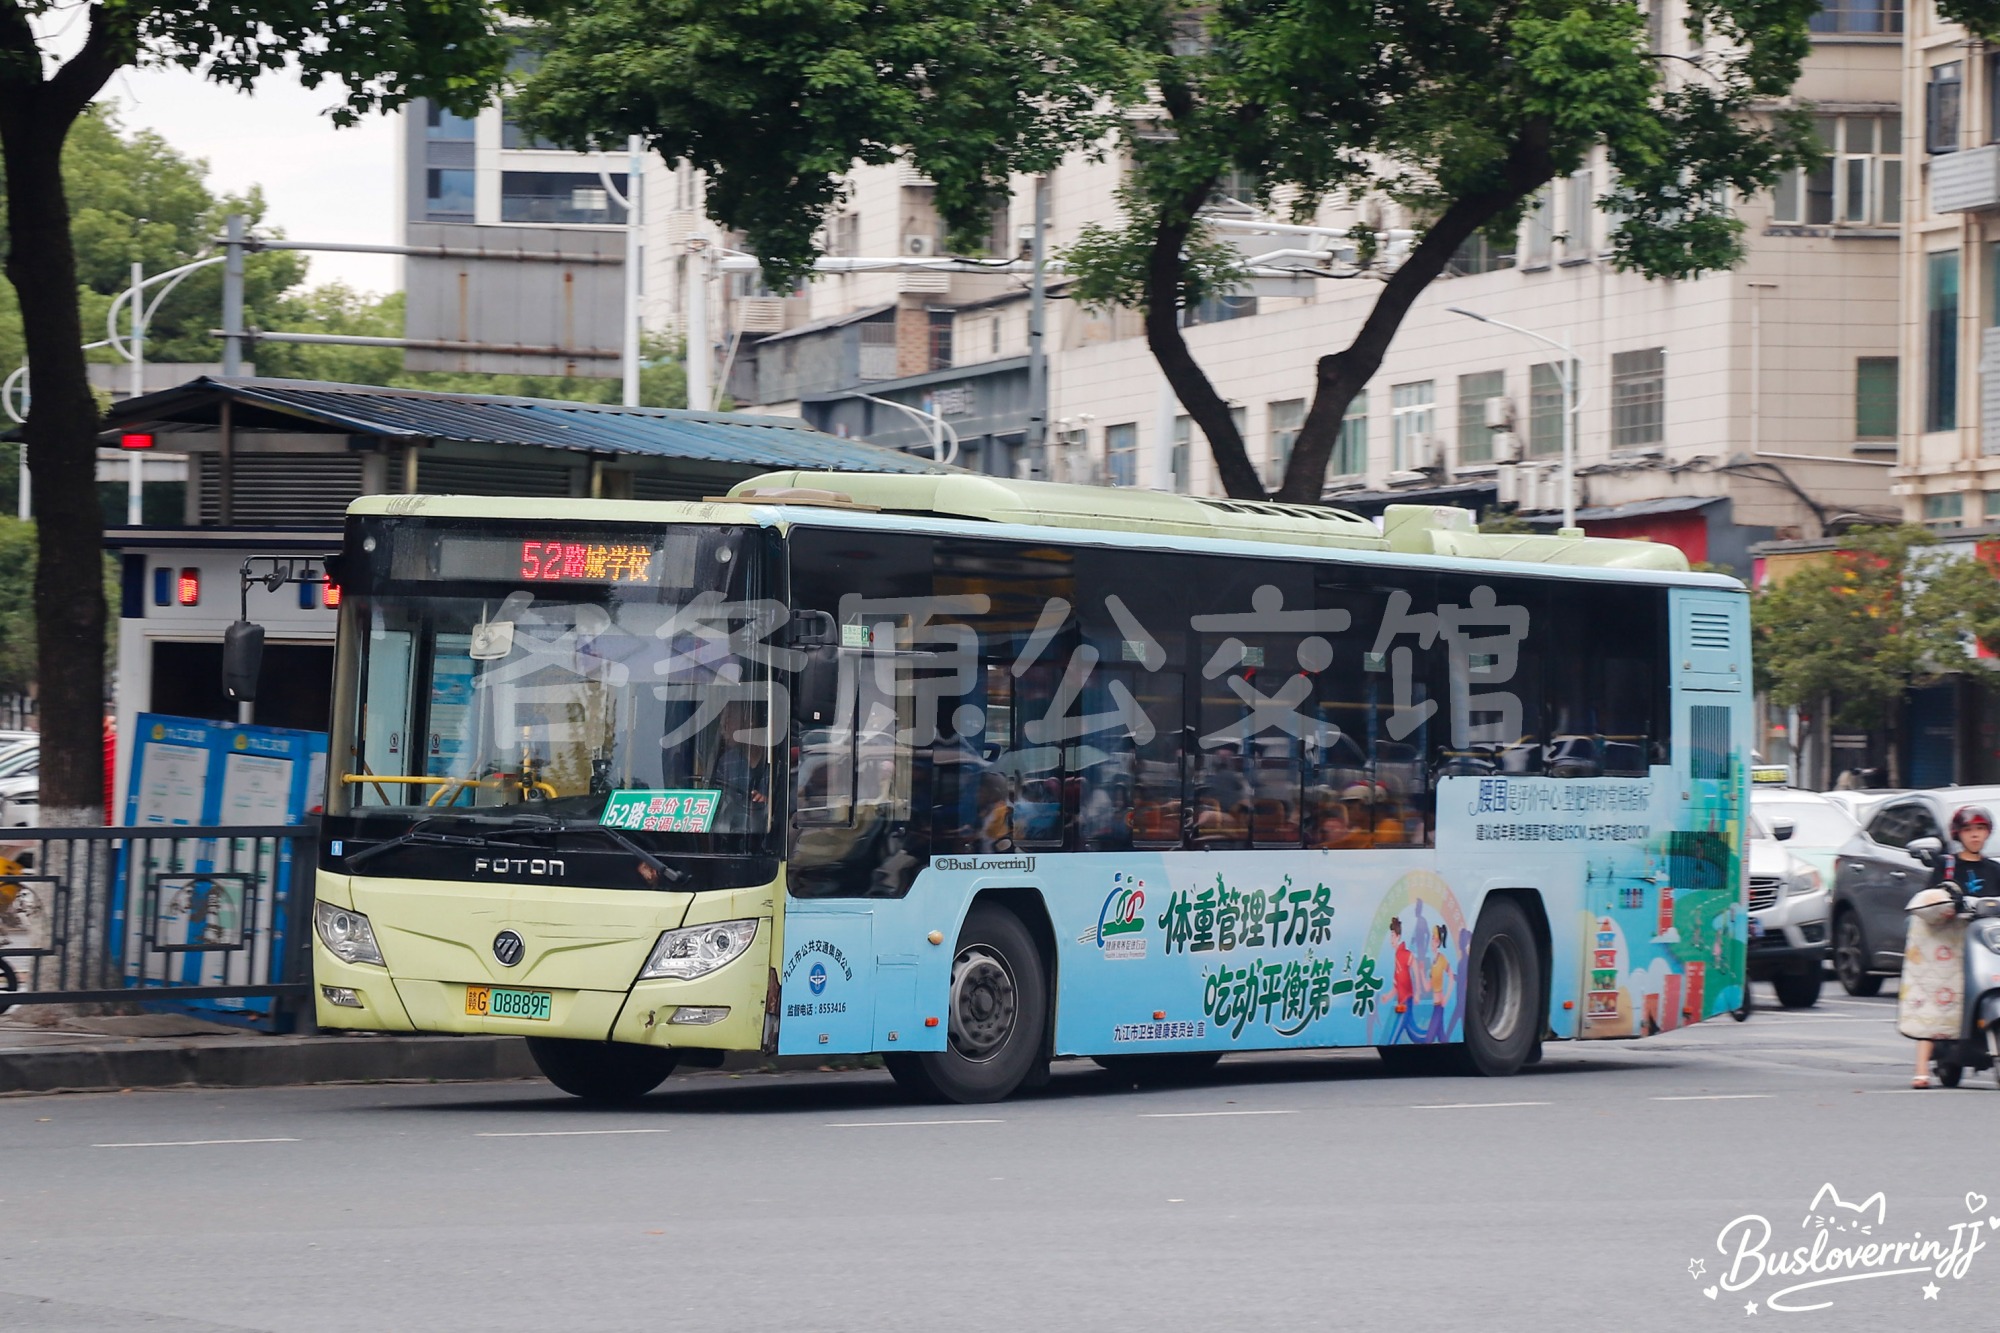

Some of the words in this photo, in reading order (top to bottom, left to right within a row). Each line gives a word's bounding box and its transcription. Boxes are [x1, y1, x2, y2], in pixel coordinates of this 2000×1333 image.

[607, 801, 646, 828] 52路
[647, 798, 679, 814] 票价
[684, 797, 710, 815] 1元
[475, 858, 564, 876] FOTON
[1158, 881, 1335, 955] 体重管理千万条
[783, 940, 853, 982] 九江市公共交通集团公司
[1203, 955, 1384, 1040] 吃动平衡第一条
[1114, 1022, 1195, 1041] 九江市卫生健康委员会
[1196, 1021, 1205, 1037] 宣
